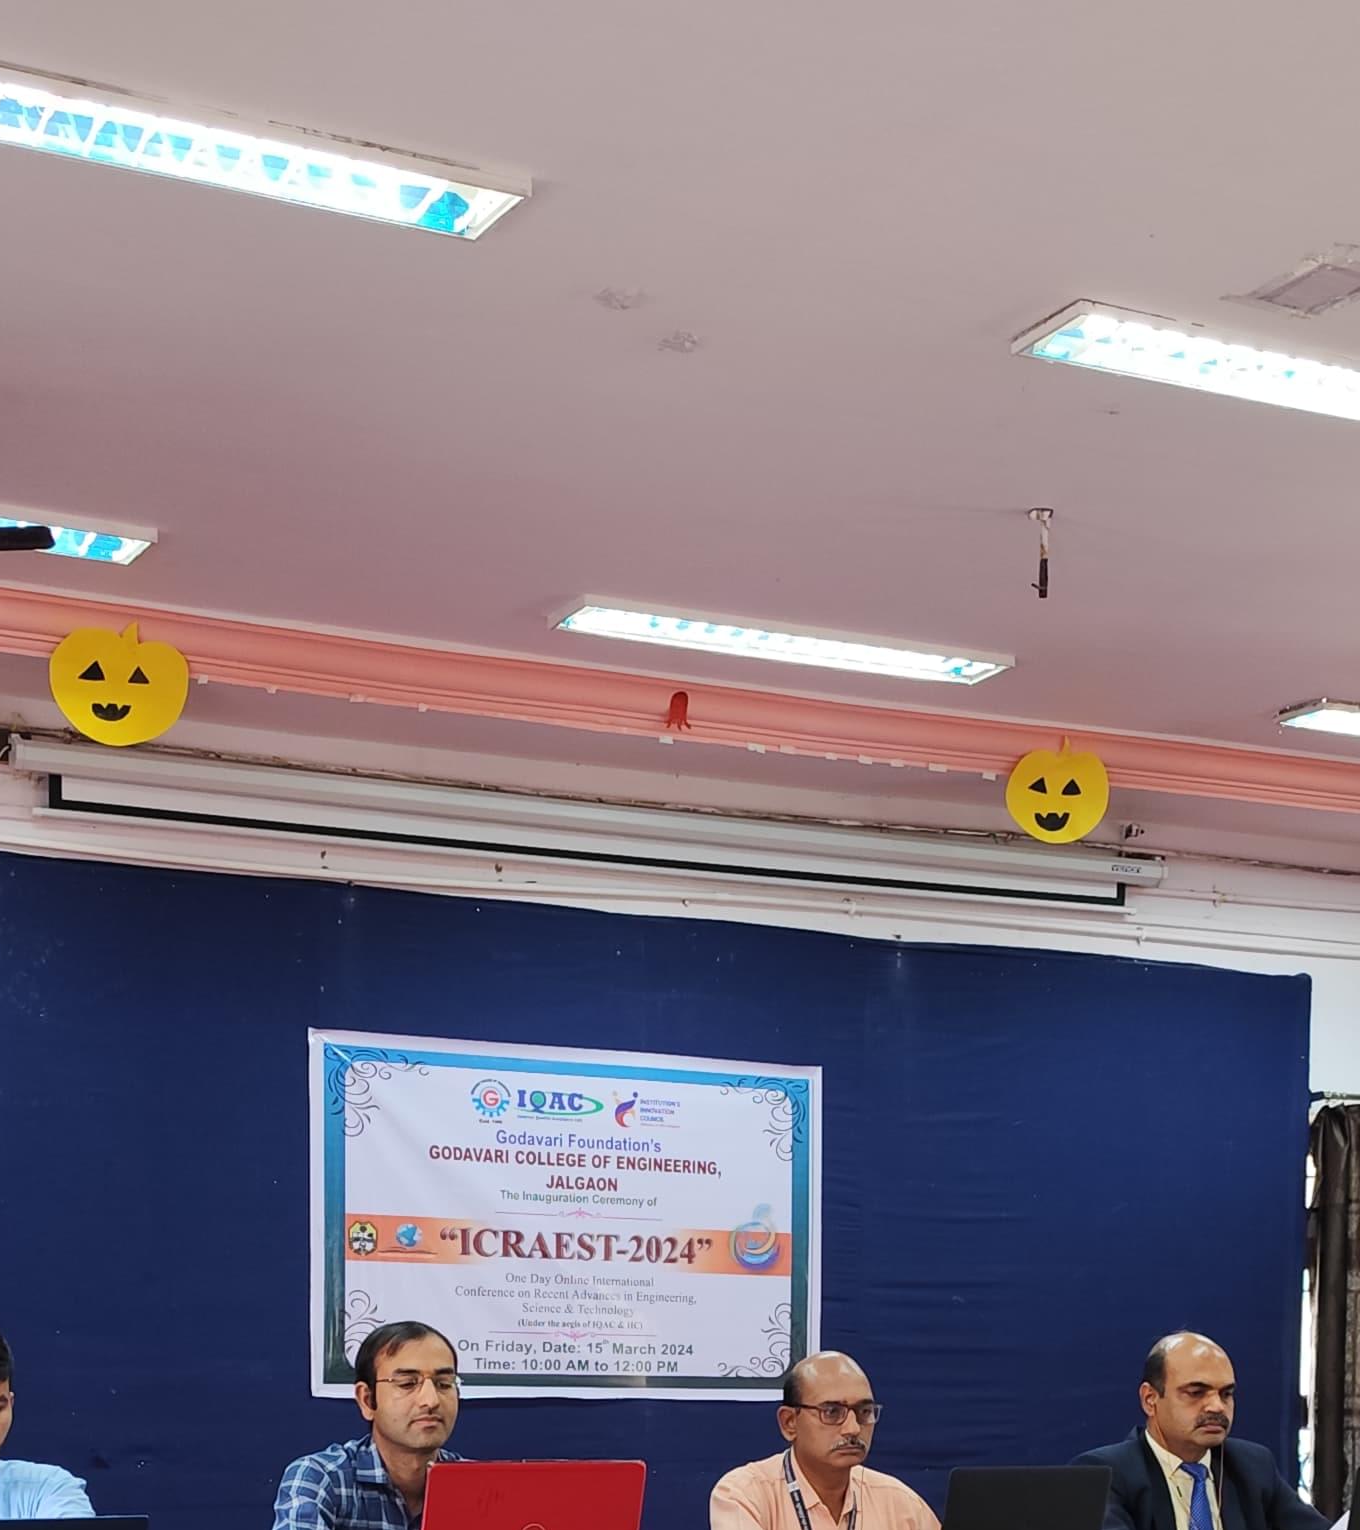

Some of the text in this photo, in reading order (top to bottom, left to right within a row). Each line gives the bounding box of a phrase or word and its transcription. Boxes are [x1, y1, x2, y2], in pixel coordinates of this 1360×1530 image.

[517, 1090, 583, 1114] IQAC
[496, 1129, 662, 1153] Godavari Foundation's
[429, 1145, 722, 1178] GODAVARI COLLEGE OF ENGINEERING,
[546, 1175, 618, 1192] JALGAON
[500, 1190, 657, 1208] The Inauguration Ceremony of
[505, 1272, 654, 1287] One Day Online International
[455, 1286, 514, 1298] Conference
[517, 1290, 531, 1299] on
[534, 1288, 569, 1300] Recent
[623, 1291, 633, 1301] in
[636, 1292, 697, 1305] Engineering,
[522, 1302, 635, 1318] Science & Technology
[518, 1319, 545, 1329] (Under
[548, 1319, 560, 1329] the
[561, 1320, 581, 1330] aegis
[582, 1320, 591, 1329] of
[457, 1339, 480, 1352] On
[485, 1340, 538, 1355] Friday,
[542, 1341, 581, 1354] Date:
[612, 1343, 656, 1356] March
[661, 1344, 693, 1356] 2024
[474, 1358, 678, 1373] Time: 10:00 AM to 12:00 PM
